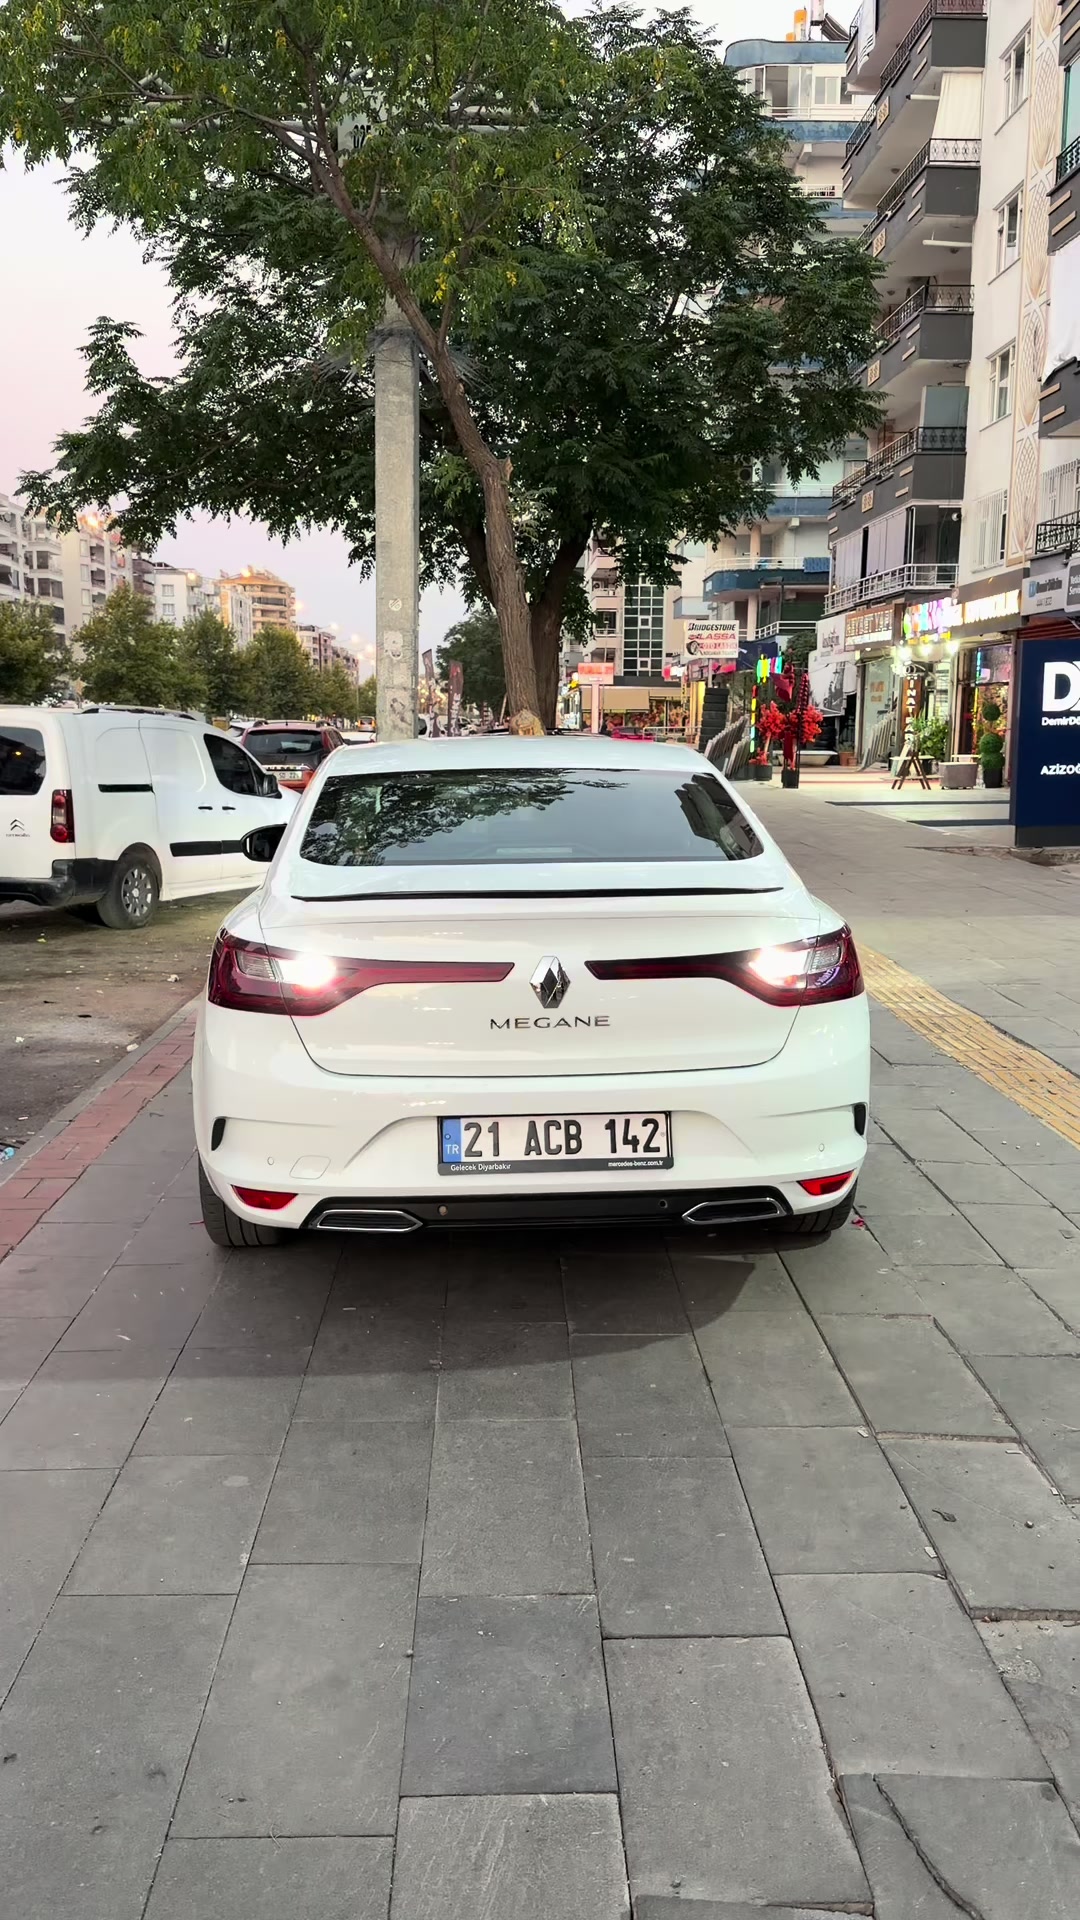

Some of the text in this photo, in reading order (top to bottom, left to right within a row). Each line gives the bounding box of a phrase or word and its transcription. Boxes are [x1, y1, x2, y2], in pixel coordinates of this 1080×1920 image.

[490, 1015, 610, 1029] MEGANE
[464, 1118, 661, 1157] 21 ACB 142
[445, 1144, 460, 1155] TR
[478, 1163, 511, 1171] Diyarbakır
